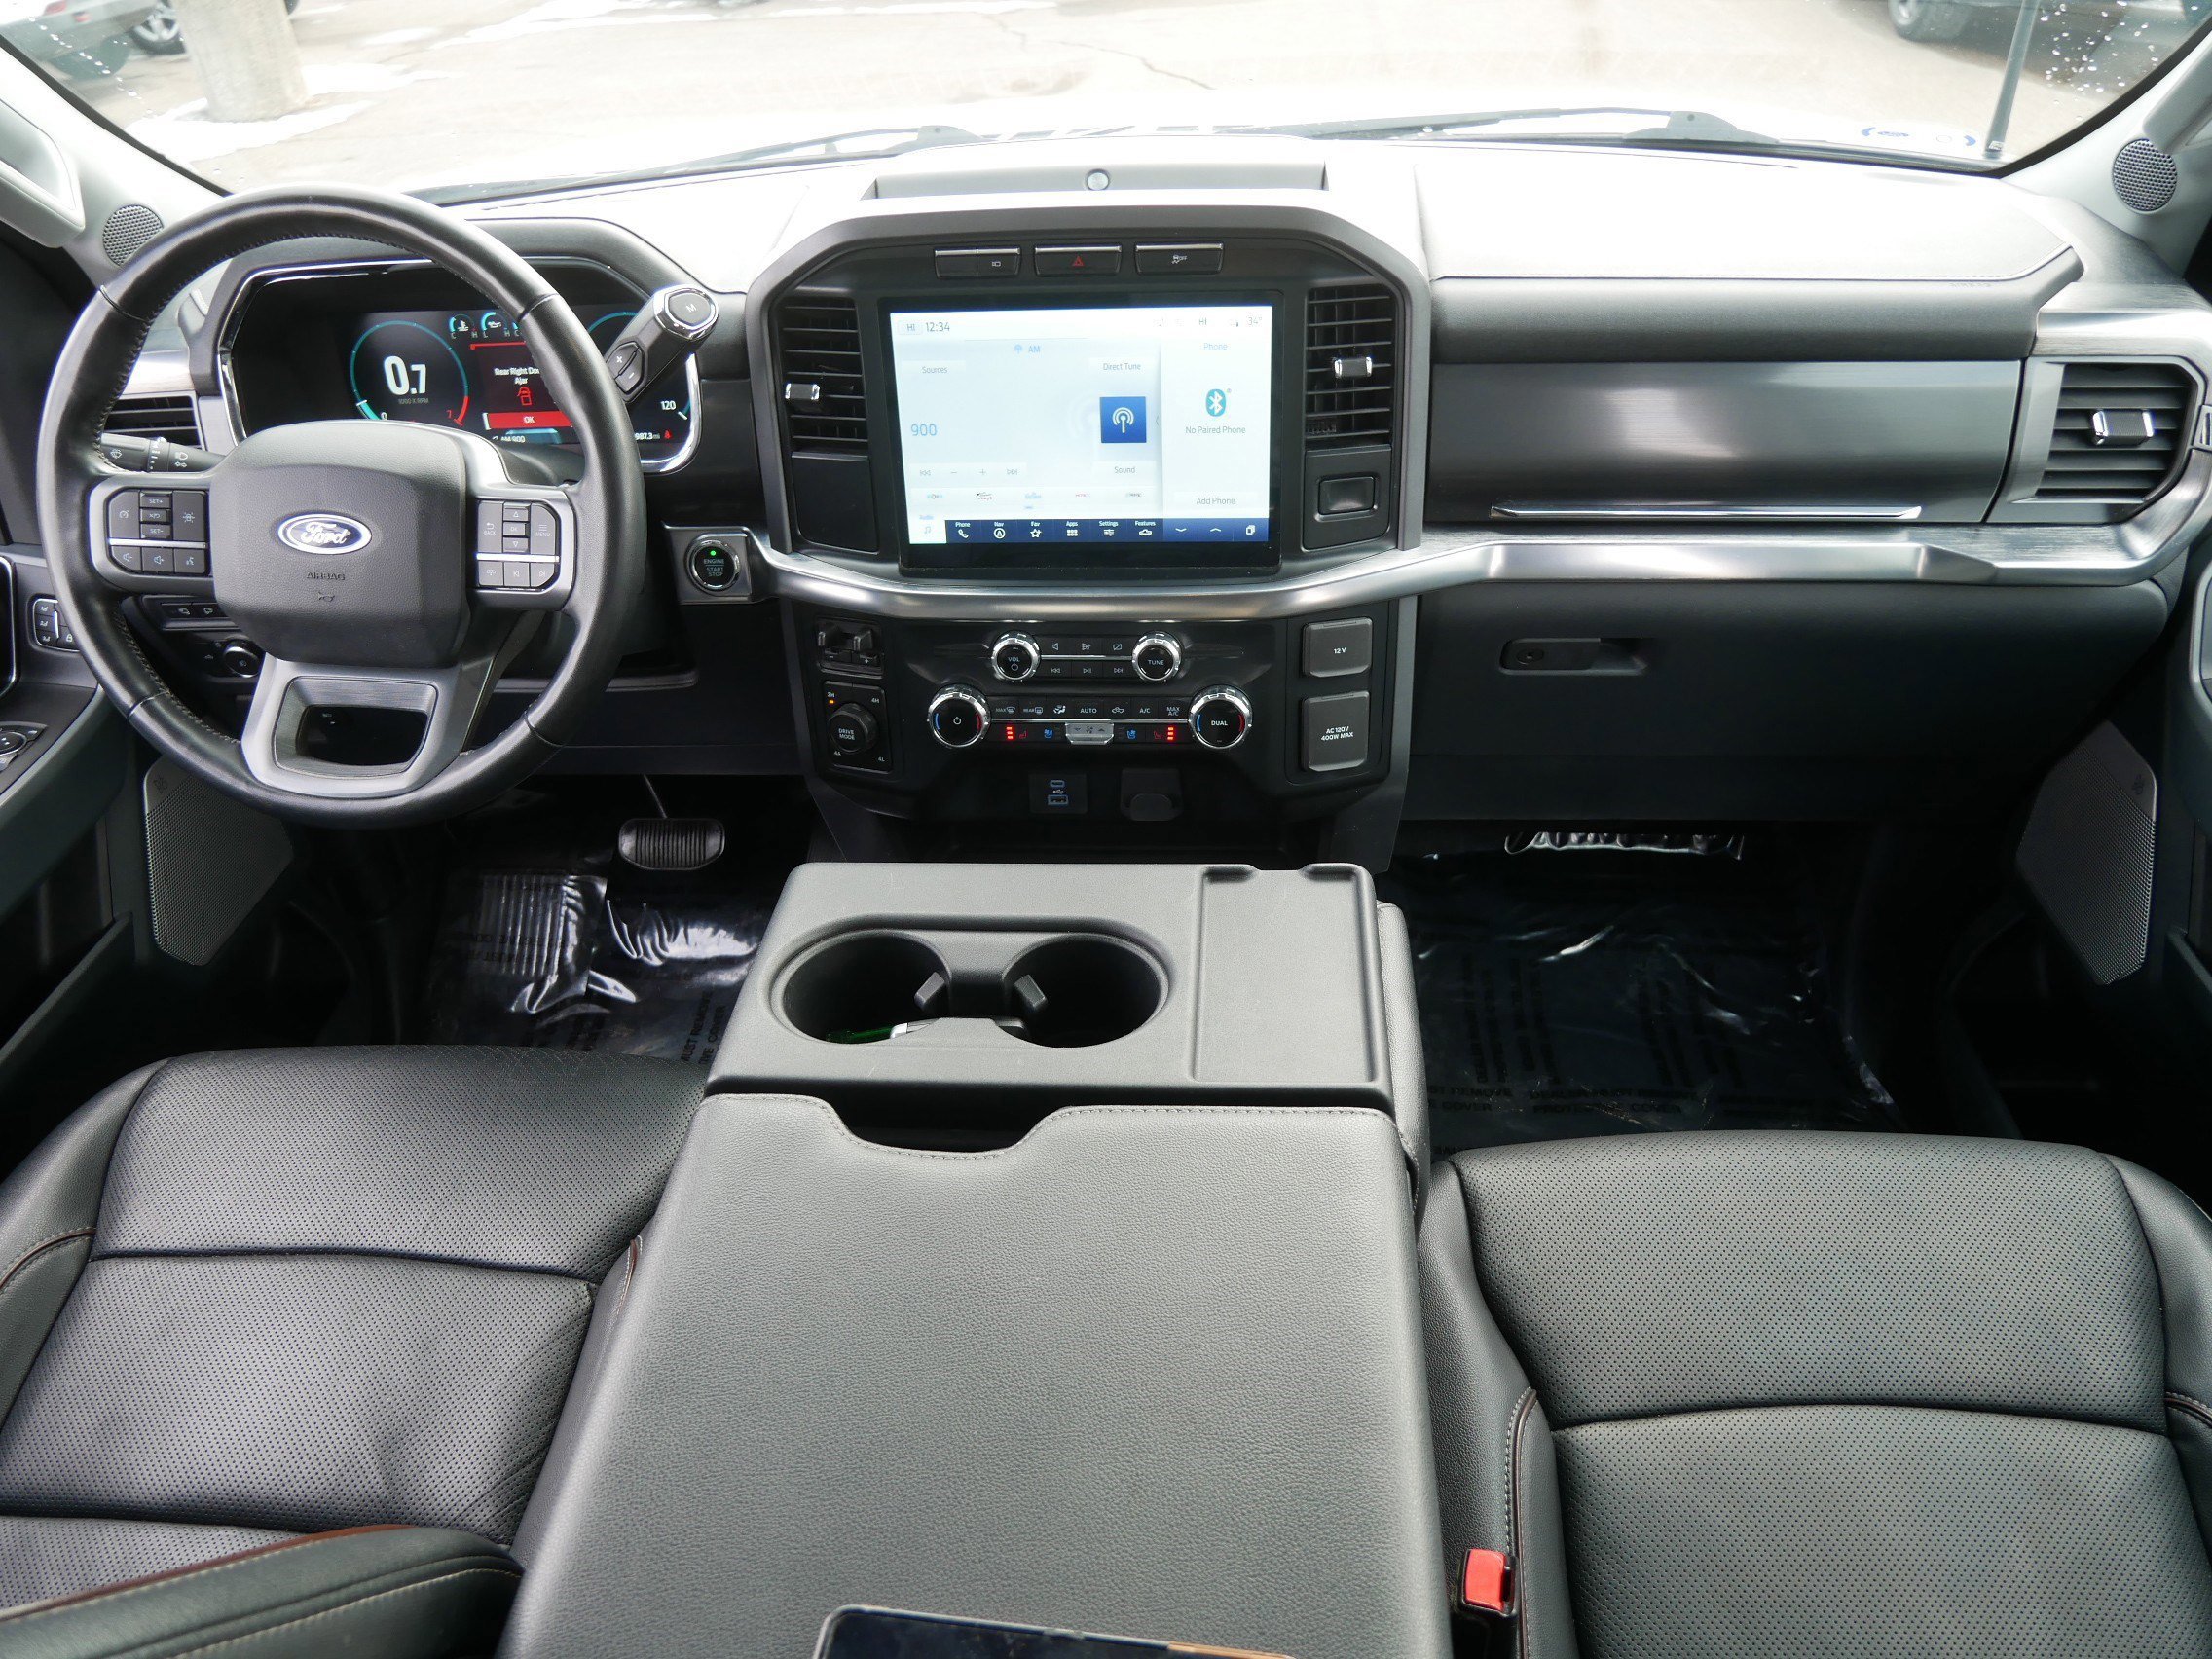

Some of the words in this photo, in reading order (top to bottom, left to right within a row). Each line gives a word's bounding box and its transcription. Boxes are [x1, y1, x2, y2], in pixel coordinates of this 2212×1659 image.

[686, 302, 697, 313] M
[906, 323, 916, 332] HI
[925, 321, 950, 332] 12:34
[1028, 345, 1041, 353] AM
[1203, 342, 1228, 350] Phone
[921, 365, 948, 375] Sources
[1102, 362, 1123, 371] Direct
[1124, 362, 1141, 371] Tune
[383, 354, 427, 396] 0.7
[660, 400, 677, 411] 120
[523, 416, 535, 424] OK
[910, 424, 938, 437] 900
[1185, 425, 1197, 434] No
[1197, 425, 1221, 434] Paired
[1222, 425, 1246, 434] Phone
[1114, 465, 1136, 474] Sound
[1196, 497, 1211, 505] Add
[1212, 497, 1236, 505] Phone
[300, 521, 351, 544] Ford
[1320, 733, 1340, 742] 400W
